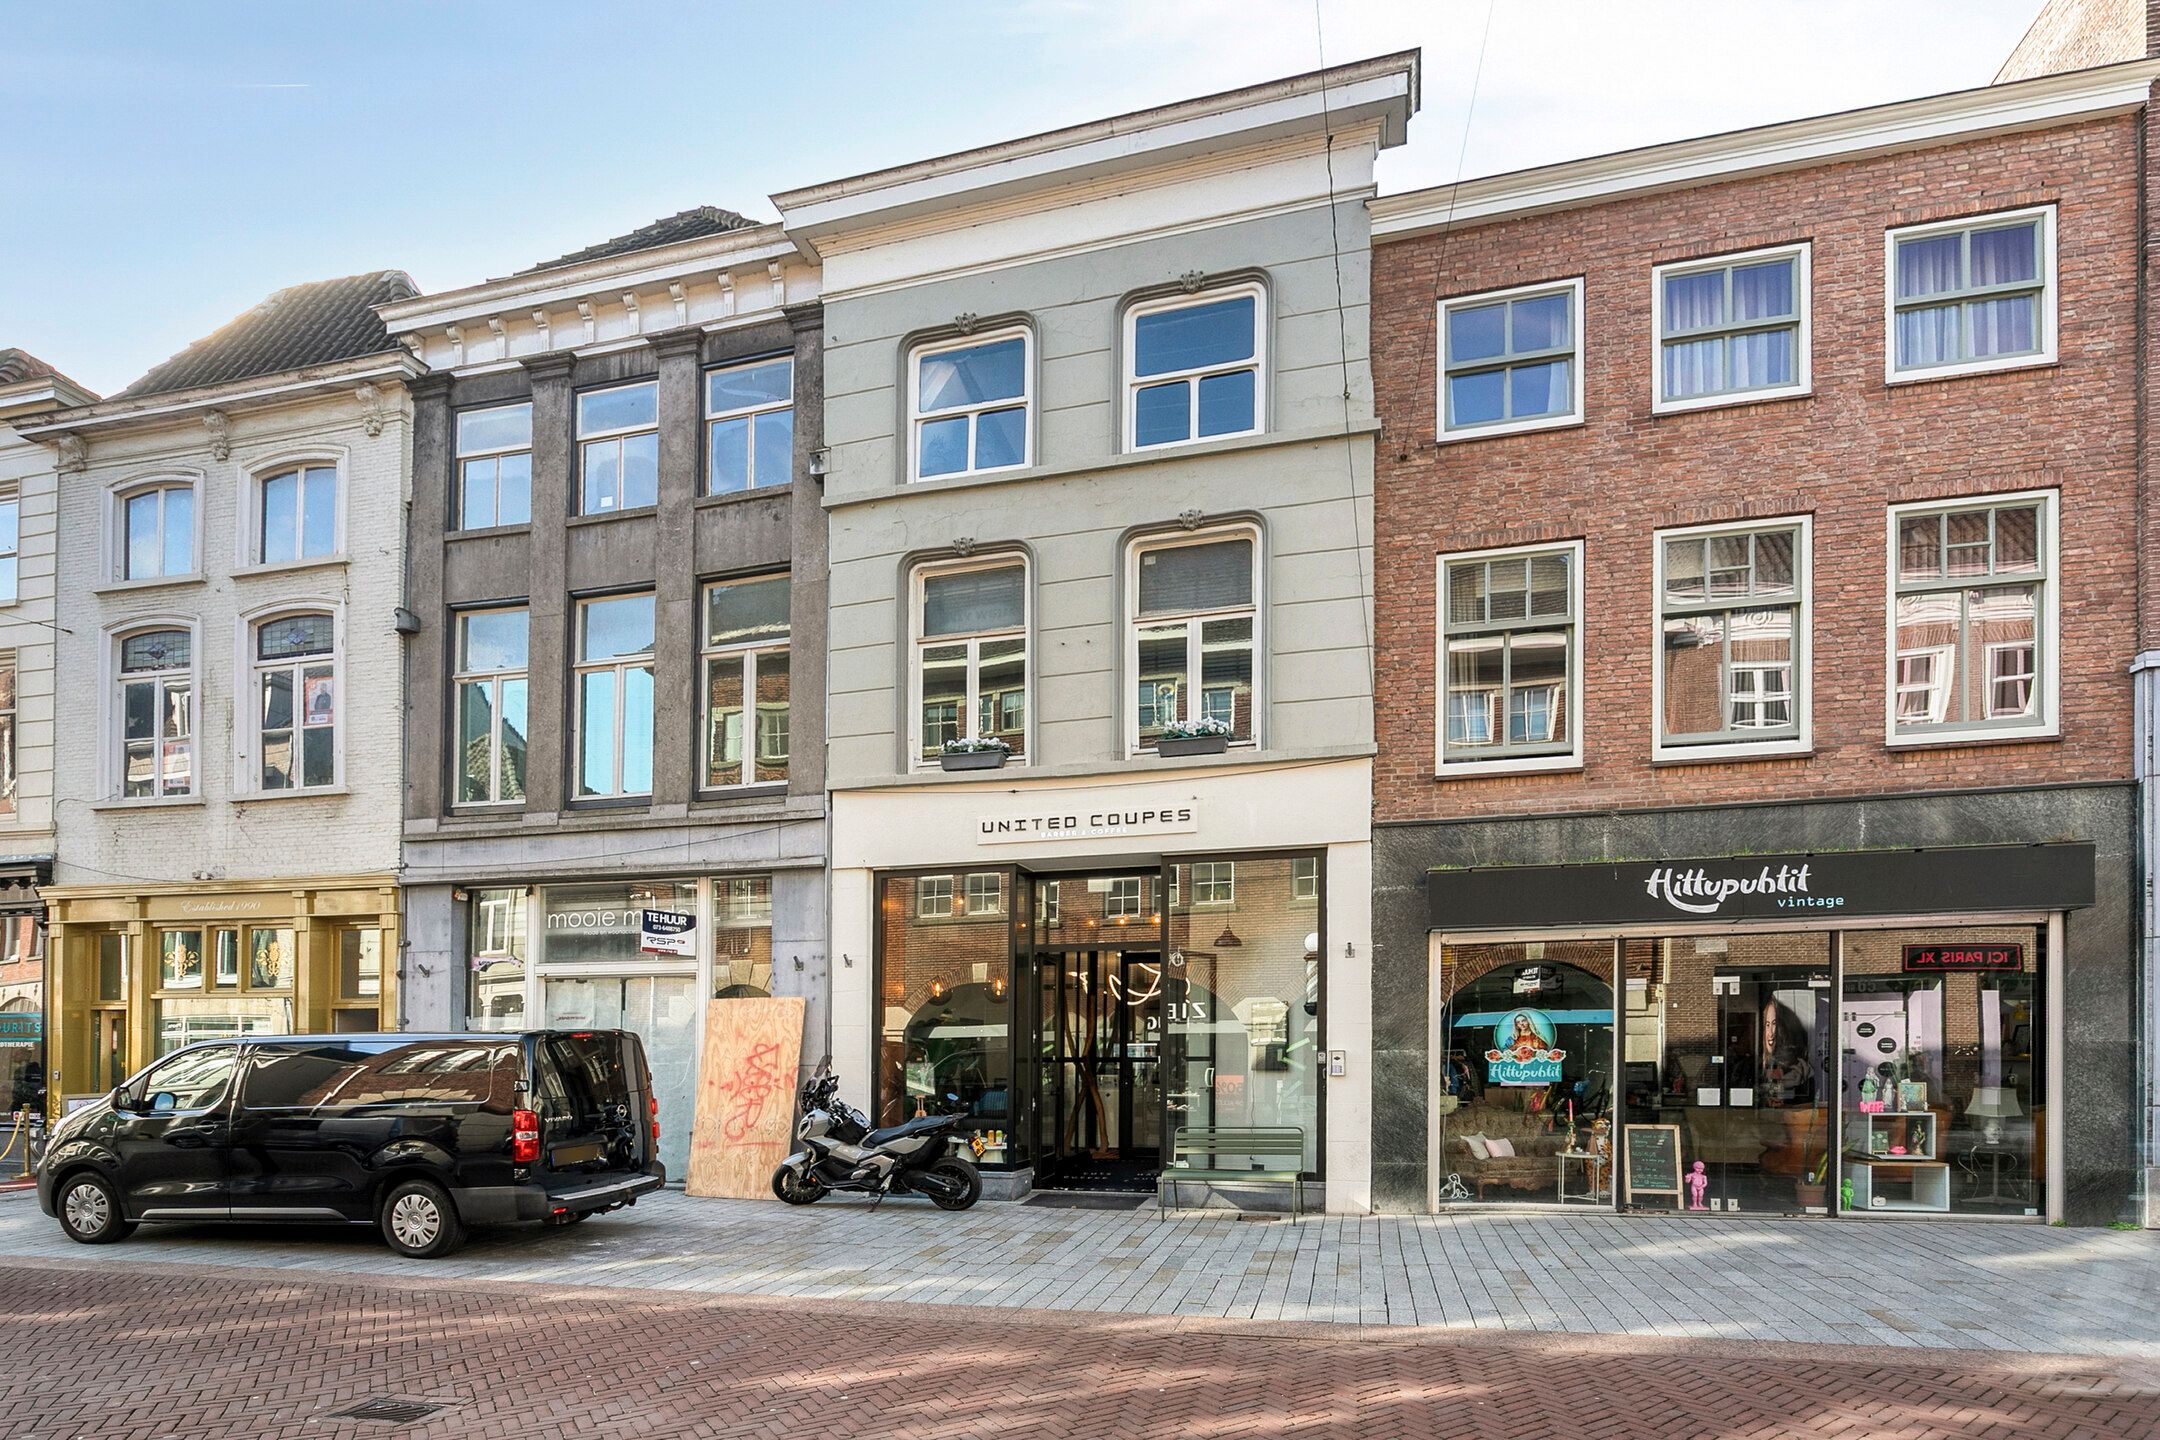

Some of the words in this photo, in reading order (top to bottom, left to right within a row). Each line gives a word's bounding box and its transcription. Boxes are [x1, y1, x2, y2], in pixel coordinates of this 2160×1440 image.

[981, 815, 1077, 833] UNITED
[1090, 809, 1191, 827] COUPES
[1040, 829, 1077, 838] BARBER
[1090, 826, 1128, 836] COFFEE
[1644, 863, 1812, 913] Hittupuhtit
[181, 901, 235, 912] Established
[236, 901, 261, 911] 1990
[1777, 896, 1844, 908] vintage
[547, 907, 616, 928] mooie
[646, 911, 659, 922] TE
[660, 913, 687, 926] HUUR
[646, 936, 676, 945] RSP
[0, 1022, 42, 1033] URITS
